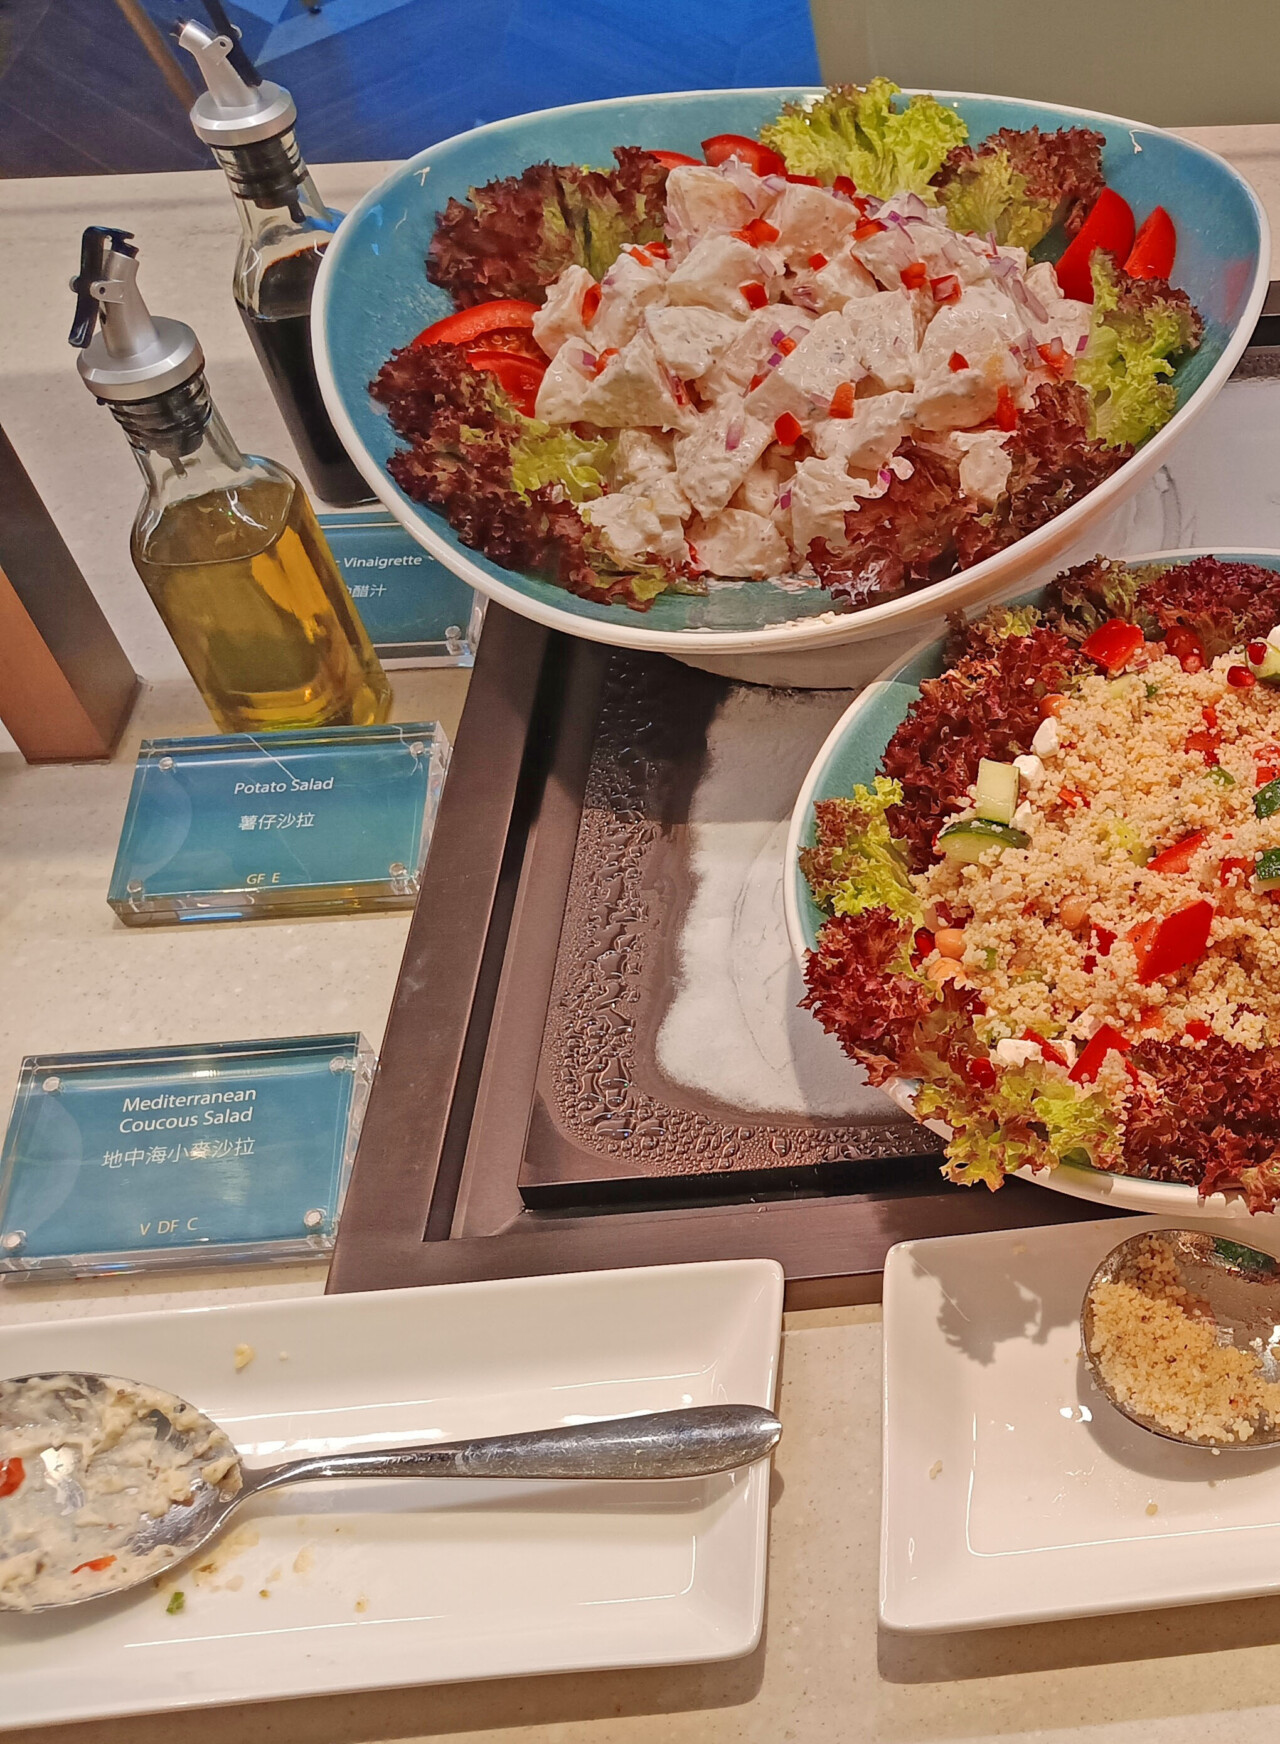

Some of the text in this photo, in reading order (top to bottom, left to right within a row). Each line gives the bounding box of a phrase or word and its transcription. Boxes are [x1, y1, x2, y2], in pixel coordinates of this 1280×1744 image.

[343, 556, 422, 570] Vinaigrette
[234, 776, 334, 795] Potato Salad
[237, 812, 316, 831] 薯仔沙拉
[246, 872, 281, 885] GF E
[122, 1089, 257, 1113] Mediterranean
[119, 1106, 254, 1134] Coucous Salad
[101, 1136, 256, 1169] 地中海小麥沙拉
[140, 1217, 199, 1236] V DF C
